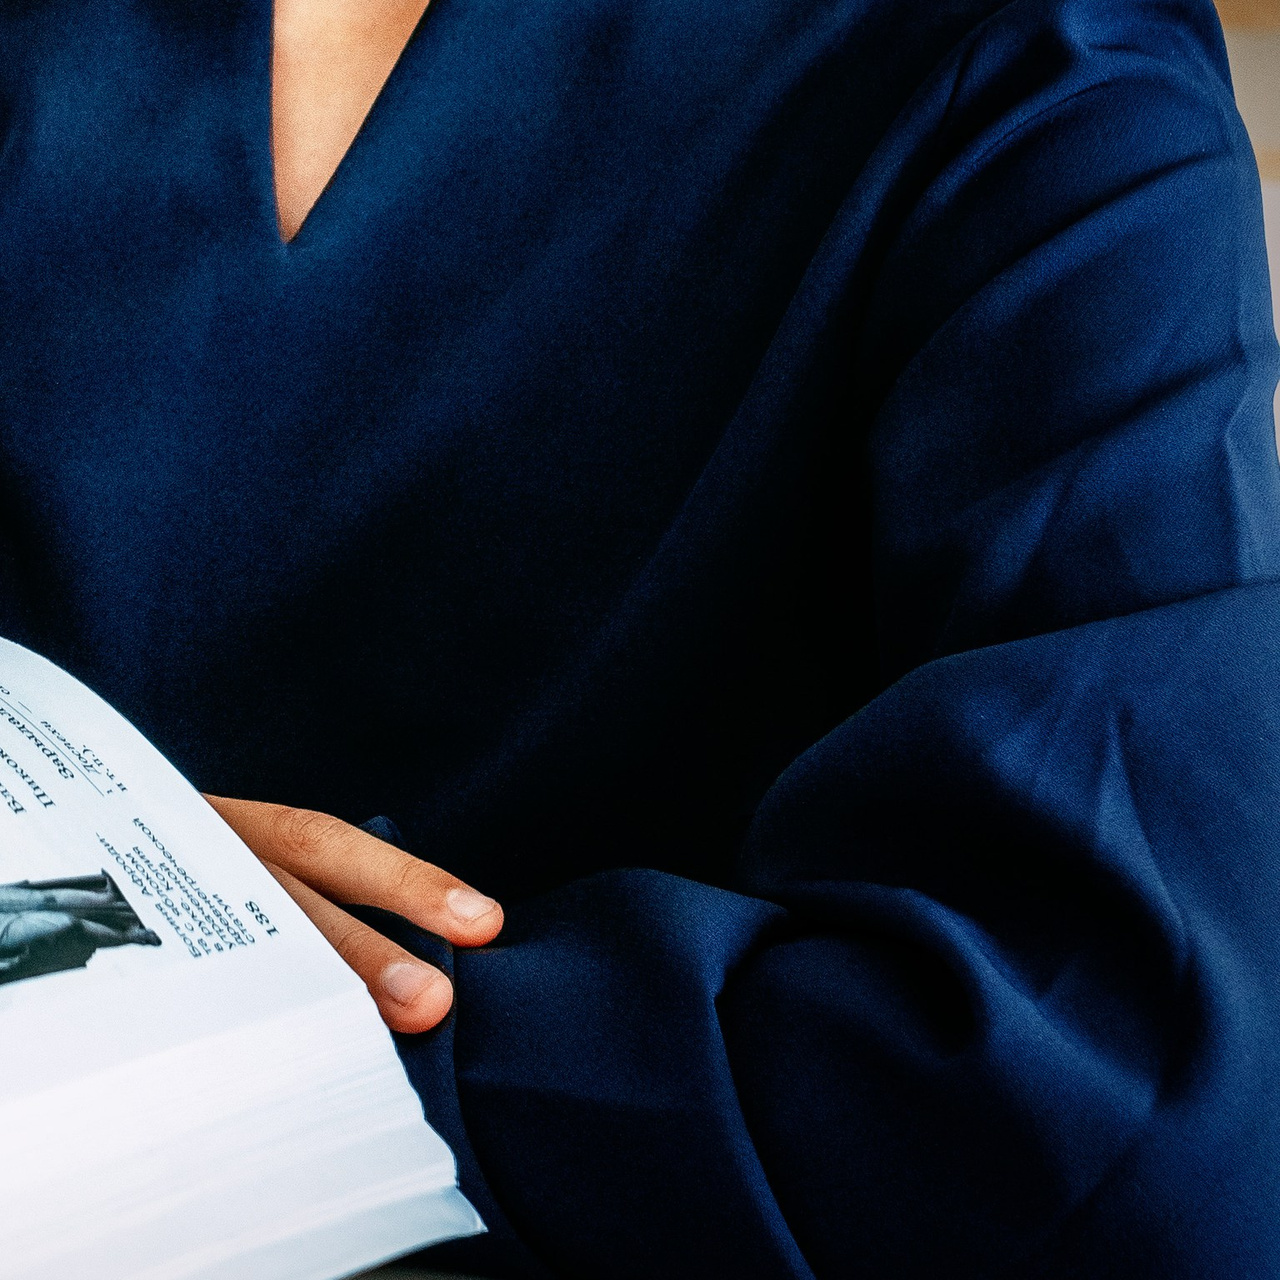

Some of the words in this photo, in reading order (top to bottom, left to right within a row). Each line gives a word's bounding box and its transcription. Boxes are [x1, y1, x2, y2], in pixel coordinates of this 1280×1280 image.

[41, 721, 101, 774] Доспехи
[96, 833, 153, 896] Афроди-
[125, 853, 181, 916] яблоком
[133, 846, 173, 891] Копия
[133, 818, 247, 946] древнегреческой
[155, 903, 202, 958] Богиня
[159, 862, 236, 950] утраченной
[181, 898, 213, 936] руке.
[212, 894, 255, 944] статуи
[245, 900, 280, 937] 138
[197, 938, 211, 955] та
